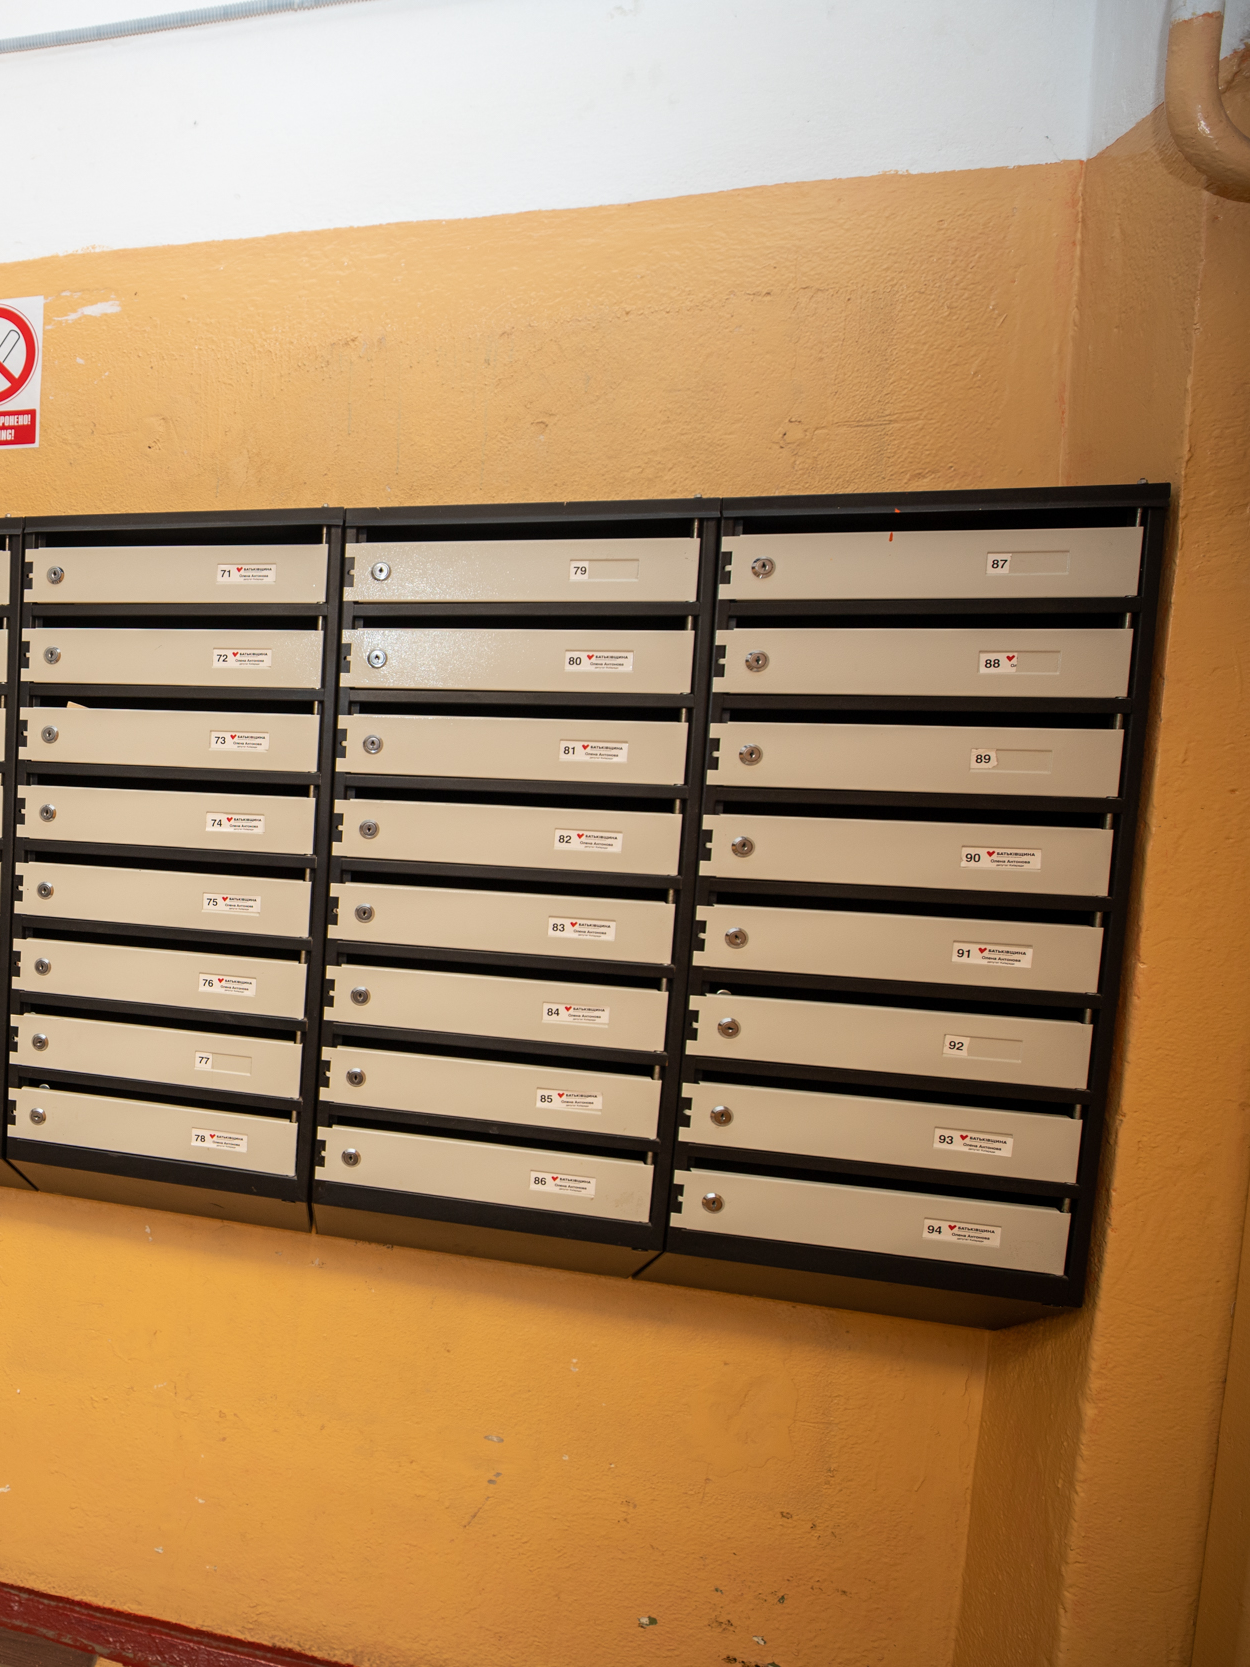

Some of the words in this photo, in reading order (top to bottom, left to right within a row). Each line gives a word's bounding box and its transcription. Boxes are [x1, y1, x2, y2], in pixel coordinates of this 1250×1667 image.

[992, 559, 1008, 569] 87
[574, 566, 586, 575] 79
[568, 657, 582, 665] 80
[985, 659, 1000, 668] 88
[564, 746, 575, 755] 81
[975, 754, 991, 764] 89
[558, 835, 571, 843] 82
[965, 853, 980, 862] 90
[207, 898, 218, 906] 75
[552, 923, 565, 932] 83
[957, 949, 970, 958] 91
[203, 979, 213, 987] 76
[547, 1008, 559, 1016] 84
[949, 1041, 964, 1051] 92
[540, 1095, 553, 1103] 85
[939, 1135, 953, 1144] 93
[969, 1136, 1007, 1145] БАТЬКІВЩИНА
[534, 1177, 546, 1185] 86
[928, 1225, 942, 1234] 94
[958, 1226, 995, 1234] БАТЬКІВЩИНА
